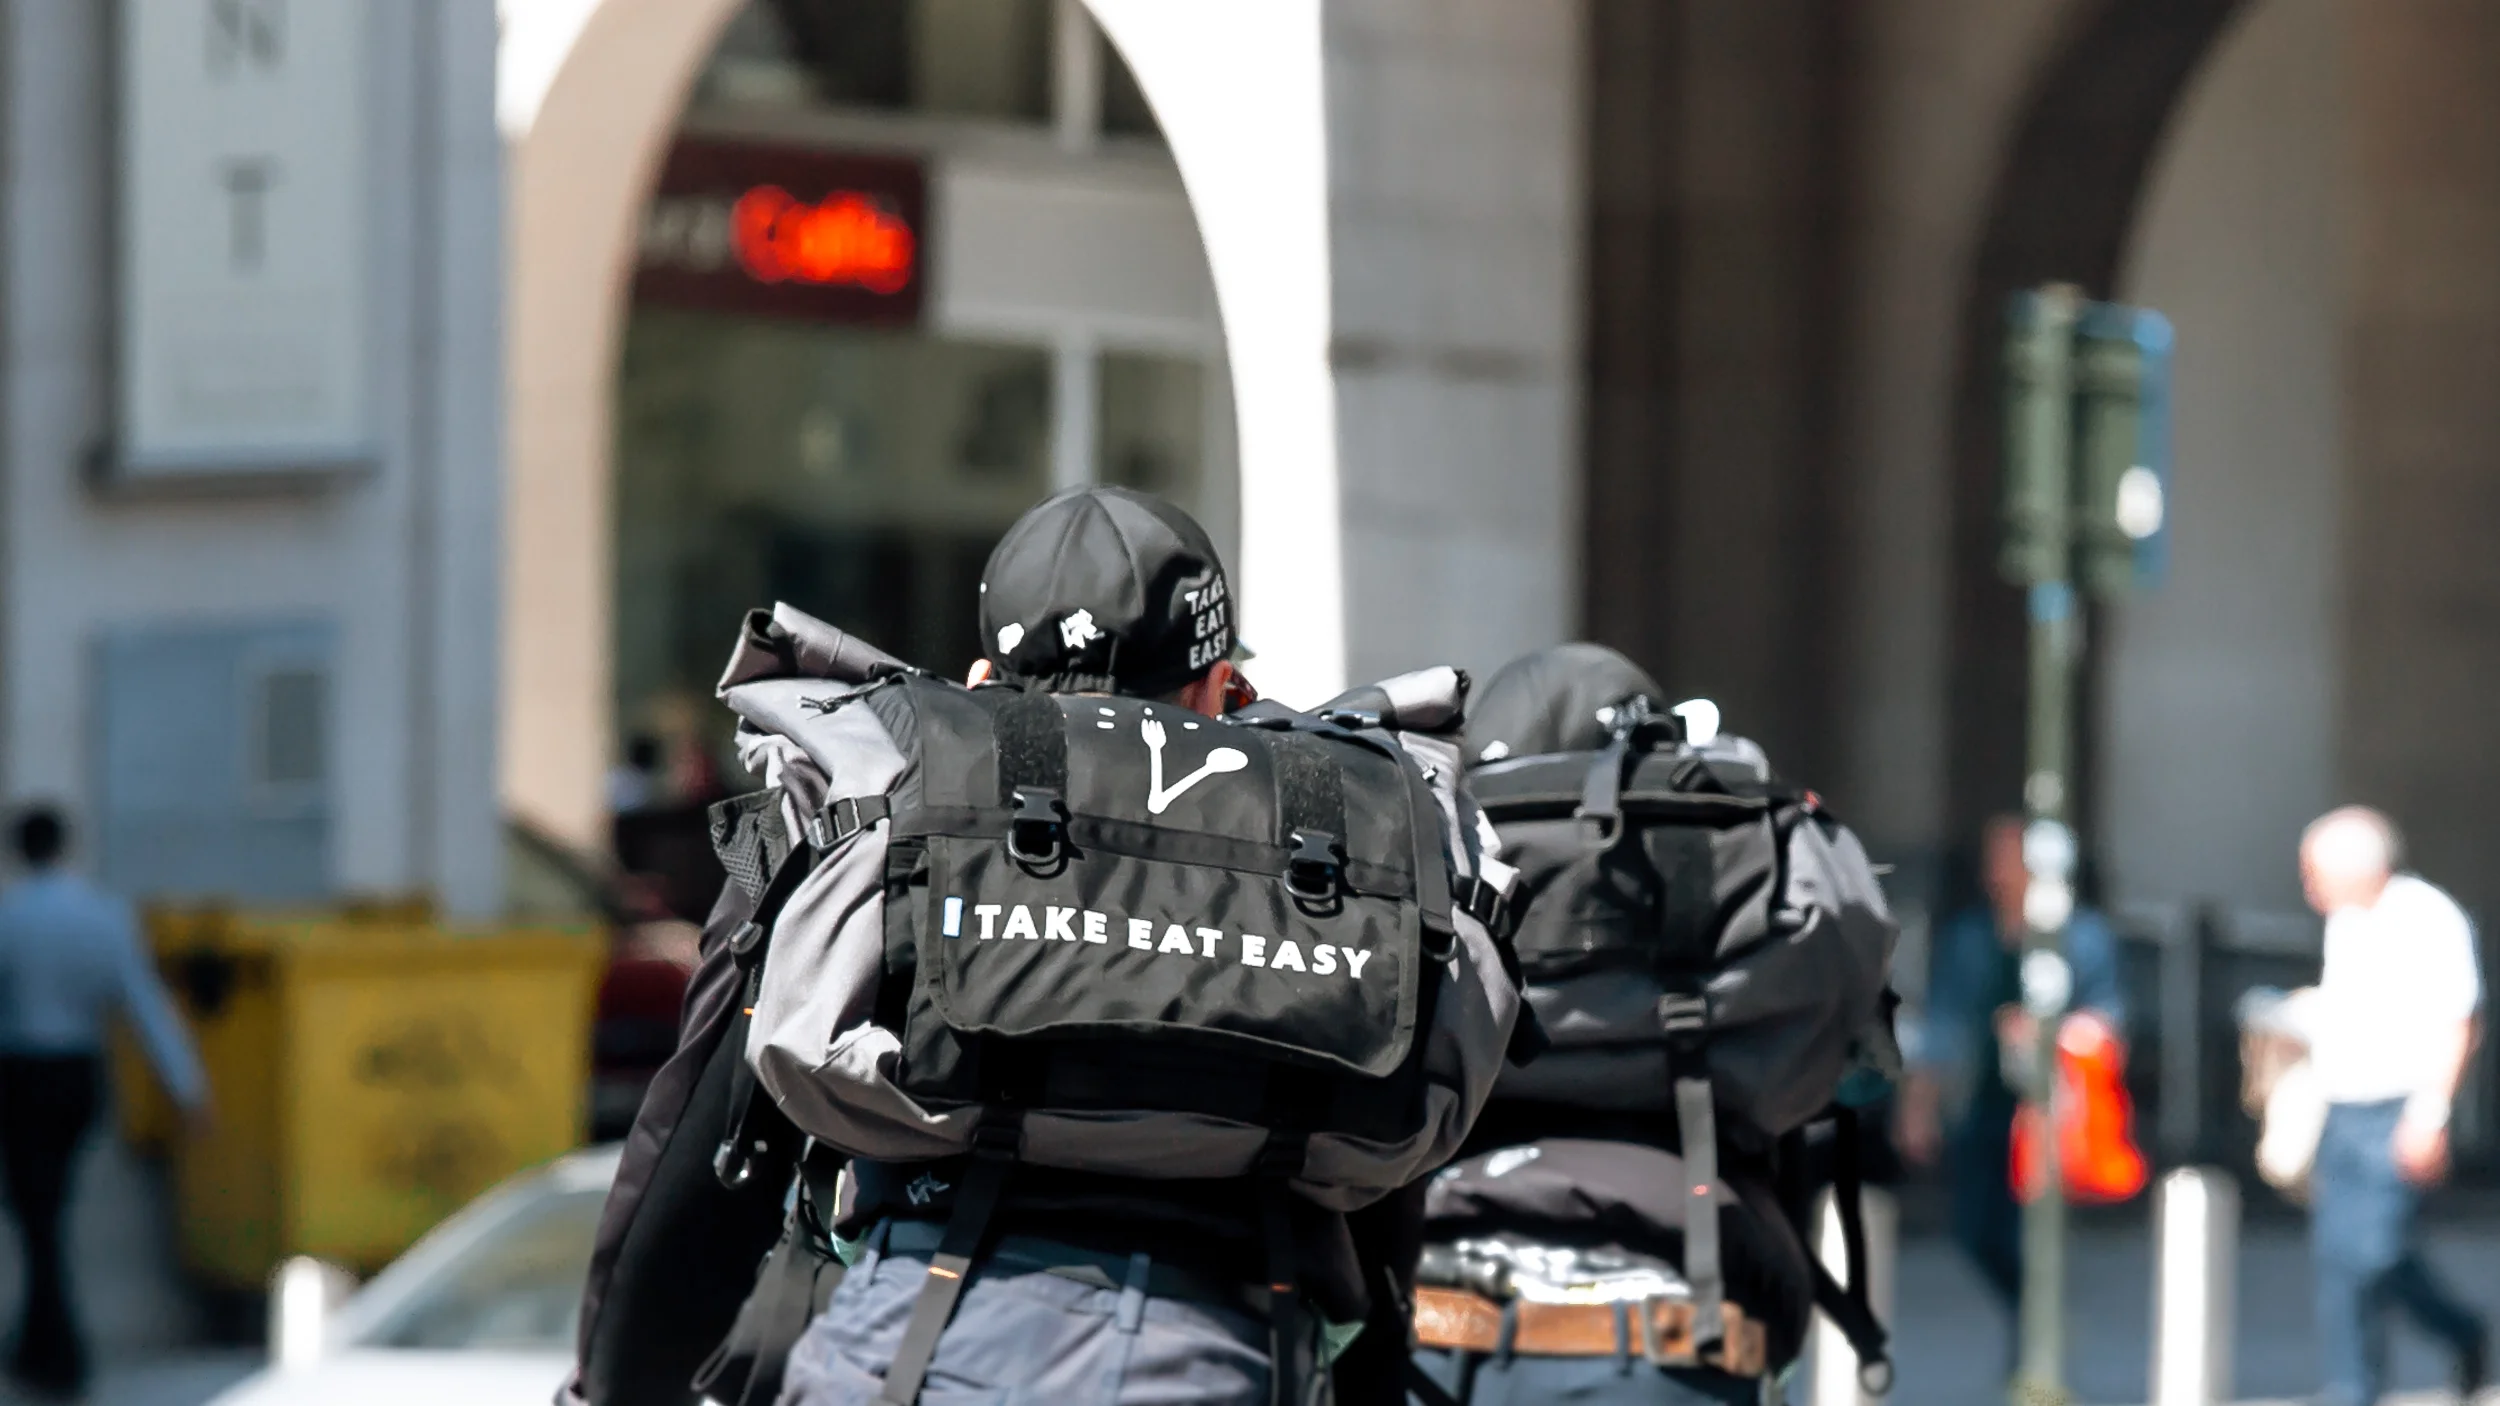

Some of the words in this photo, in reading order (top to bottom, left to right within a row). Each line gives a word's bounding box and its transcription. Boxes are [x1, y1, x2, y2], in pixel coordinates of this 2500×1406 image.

[1196, 602, 1225, 639] EAT
[1188, 627, 1228, 670] EASY
[974, 904, 1108, 944] TAKE
[1127, 917, 1223, 958] EAT
[1240, 933, 1372, 980] EASY
